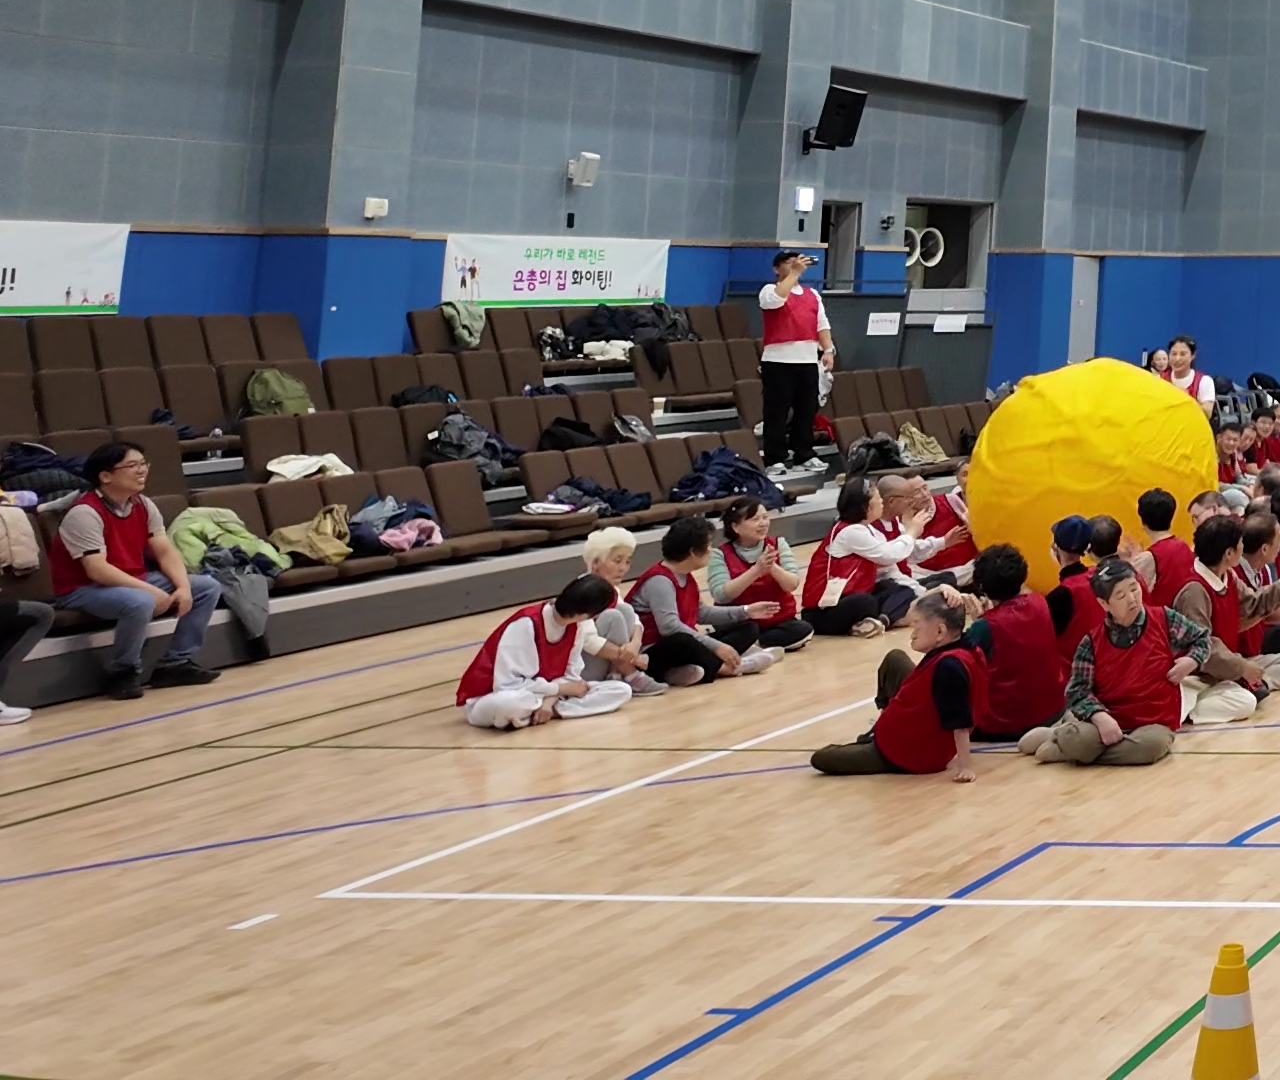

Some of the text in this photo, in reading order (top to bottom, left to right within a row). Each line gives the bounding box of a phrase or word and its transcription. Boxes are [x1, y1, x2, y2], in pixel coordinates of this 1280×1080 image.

[524, 247, 606, 265] 우리가 바로 레전드
[555, 269, 567, 291] 집
[571, 269, 613, 291] 화이팅!
